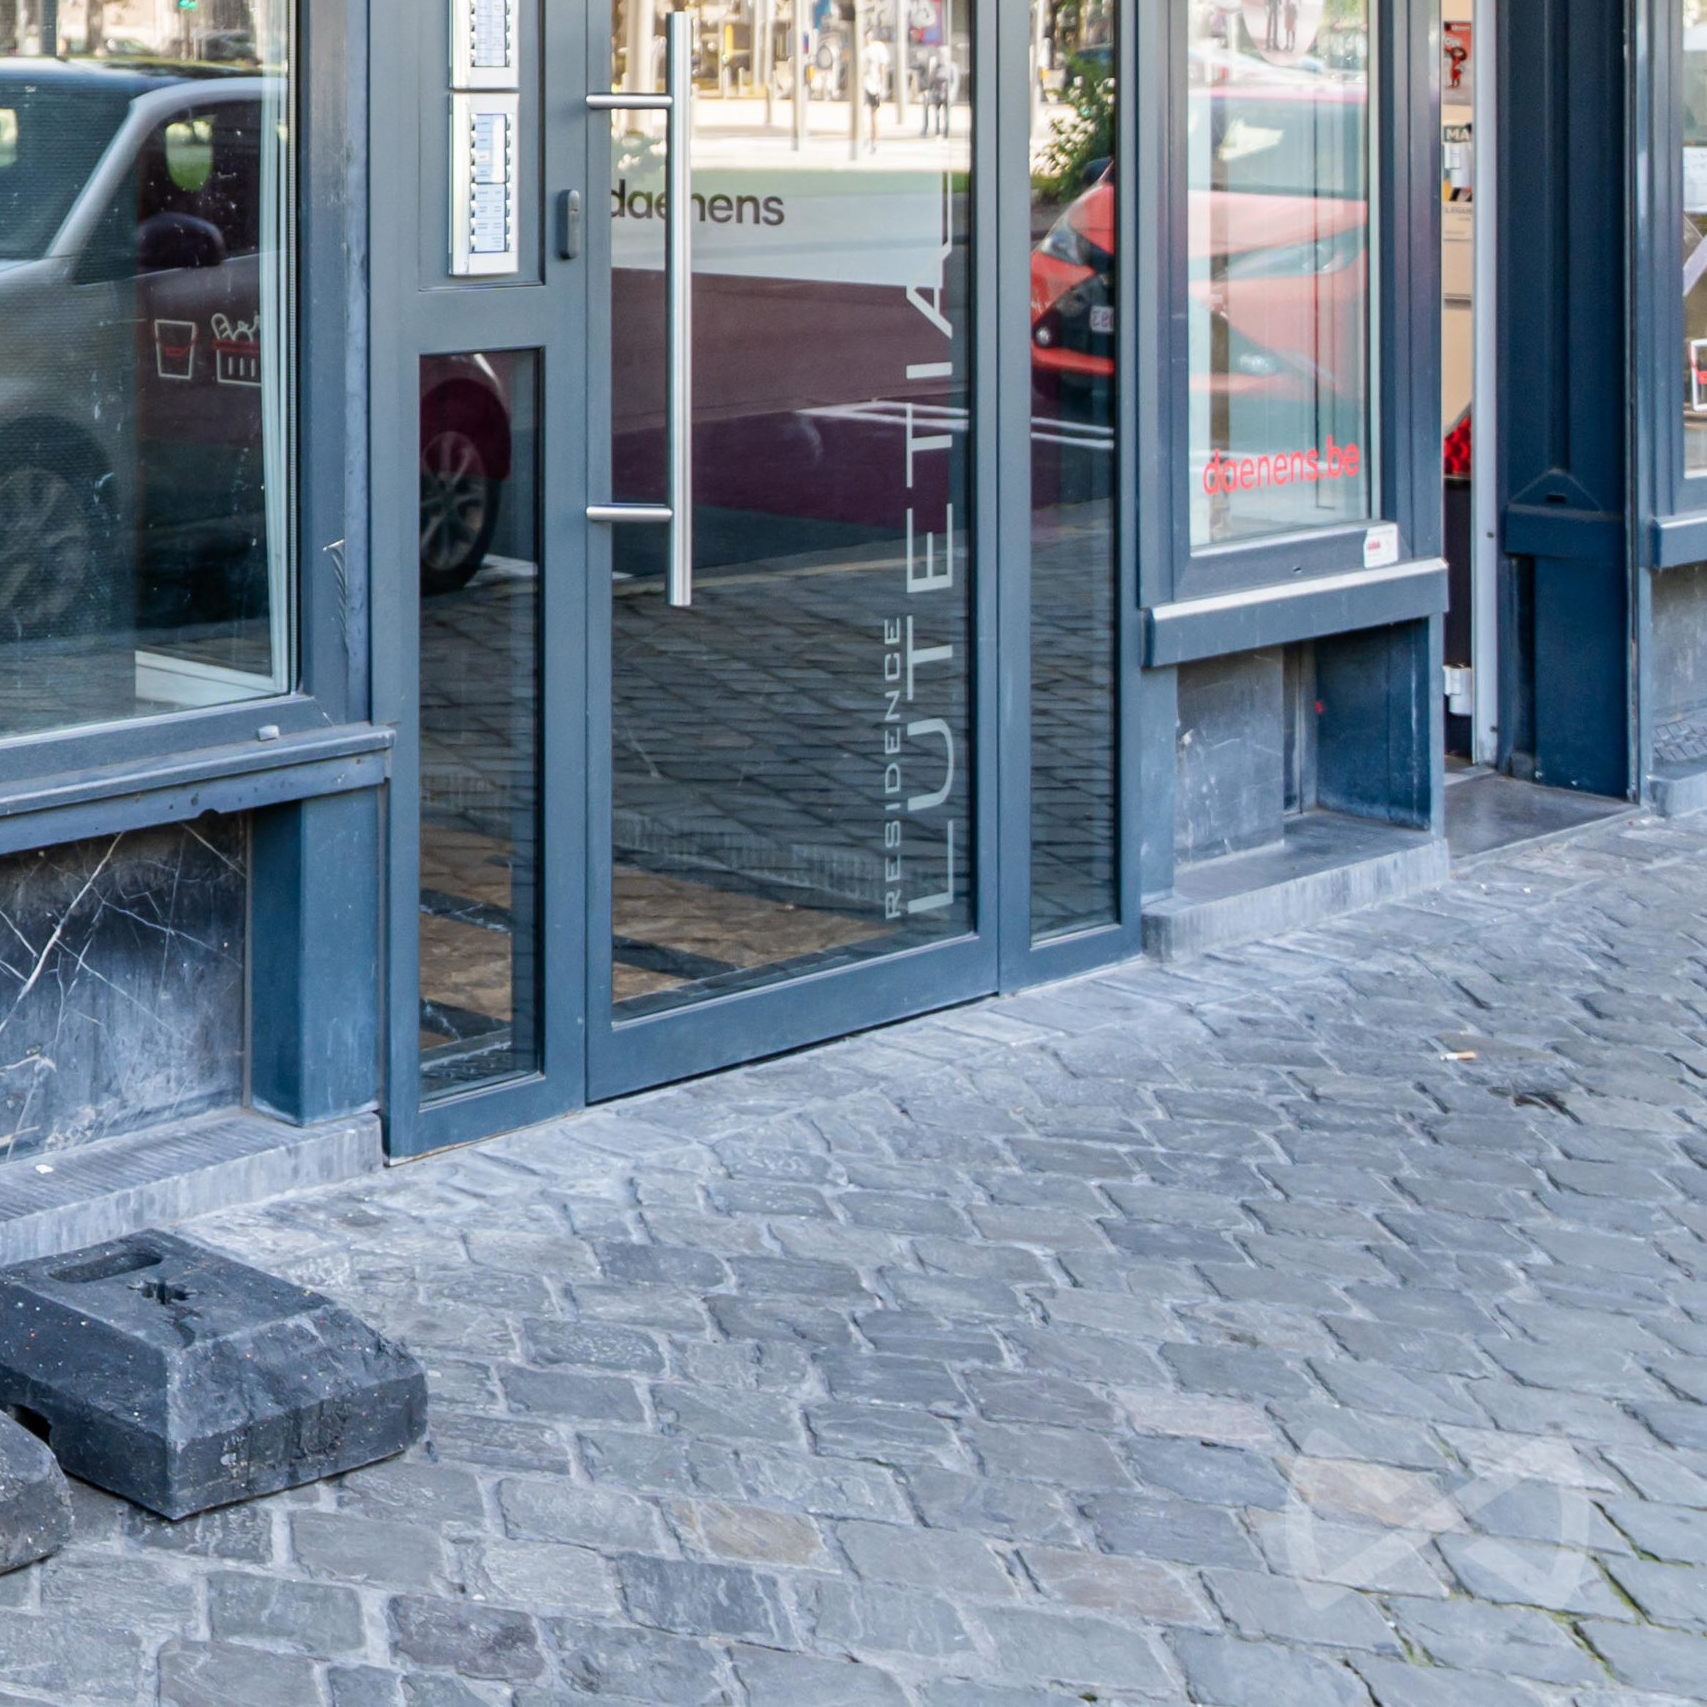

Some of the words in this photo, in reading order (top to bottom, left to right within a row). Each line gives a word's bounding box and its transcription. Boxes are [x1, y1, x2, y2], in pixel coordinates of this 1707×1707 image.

[906, 241, 954, 914] LUTETIA
[1203, 434, 1360, 495] daenens.be
[885, 617, 901, 919] RESIDENCE
